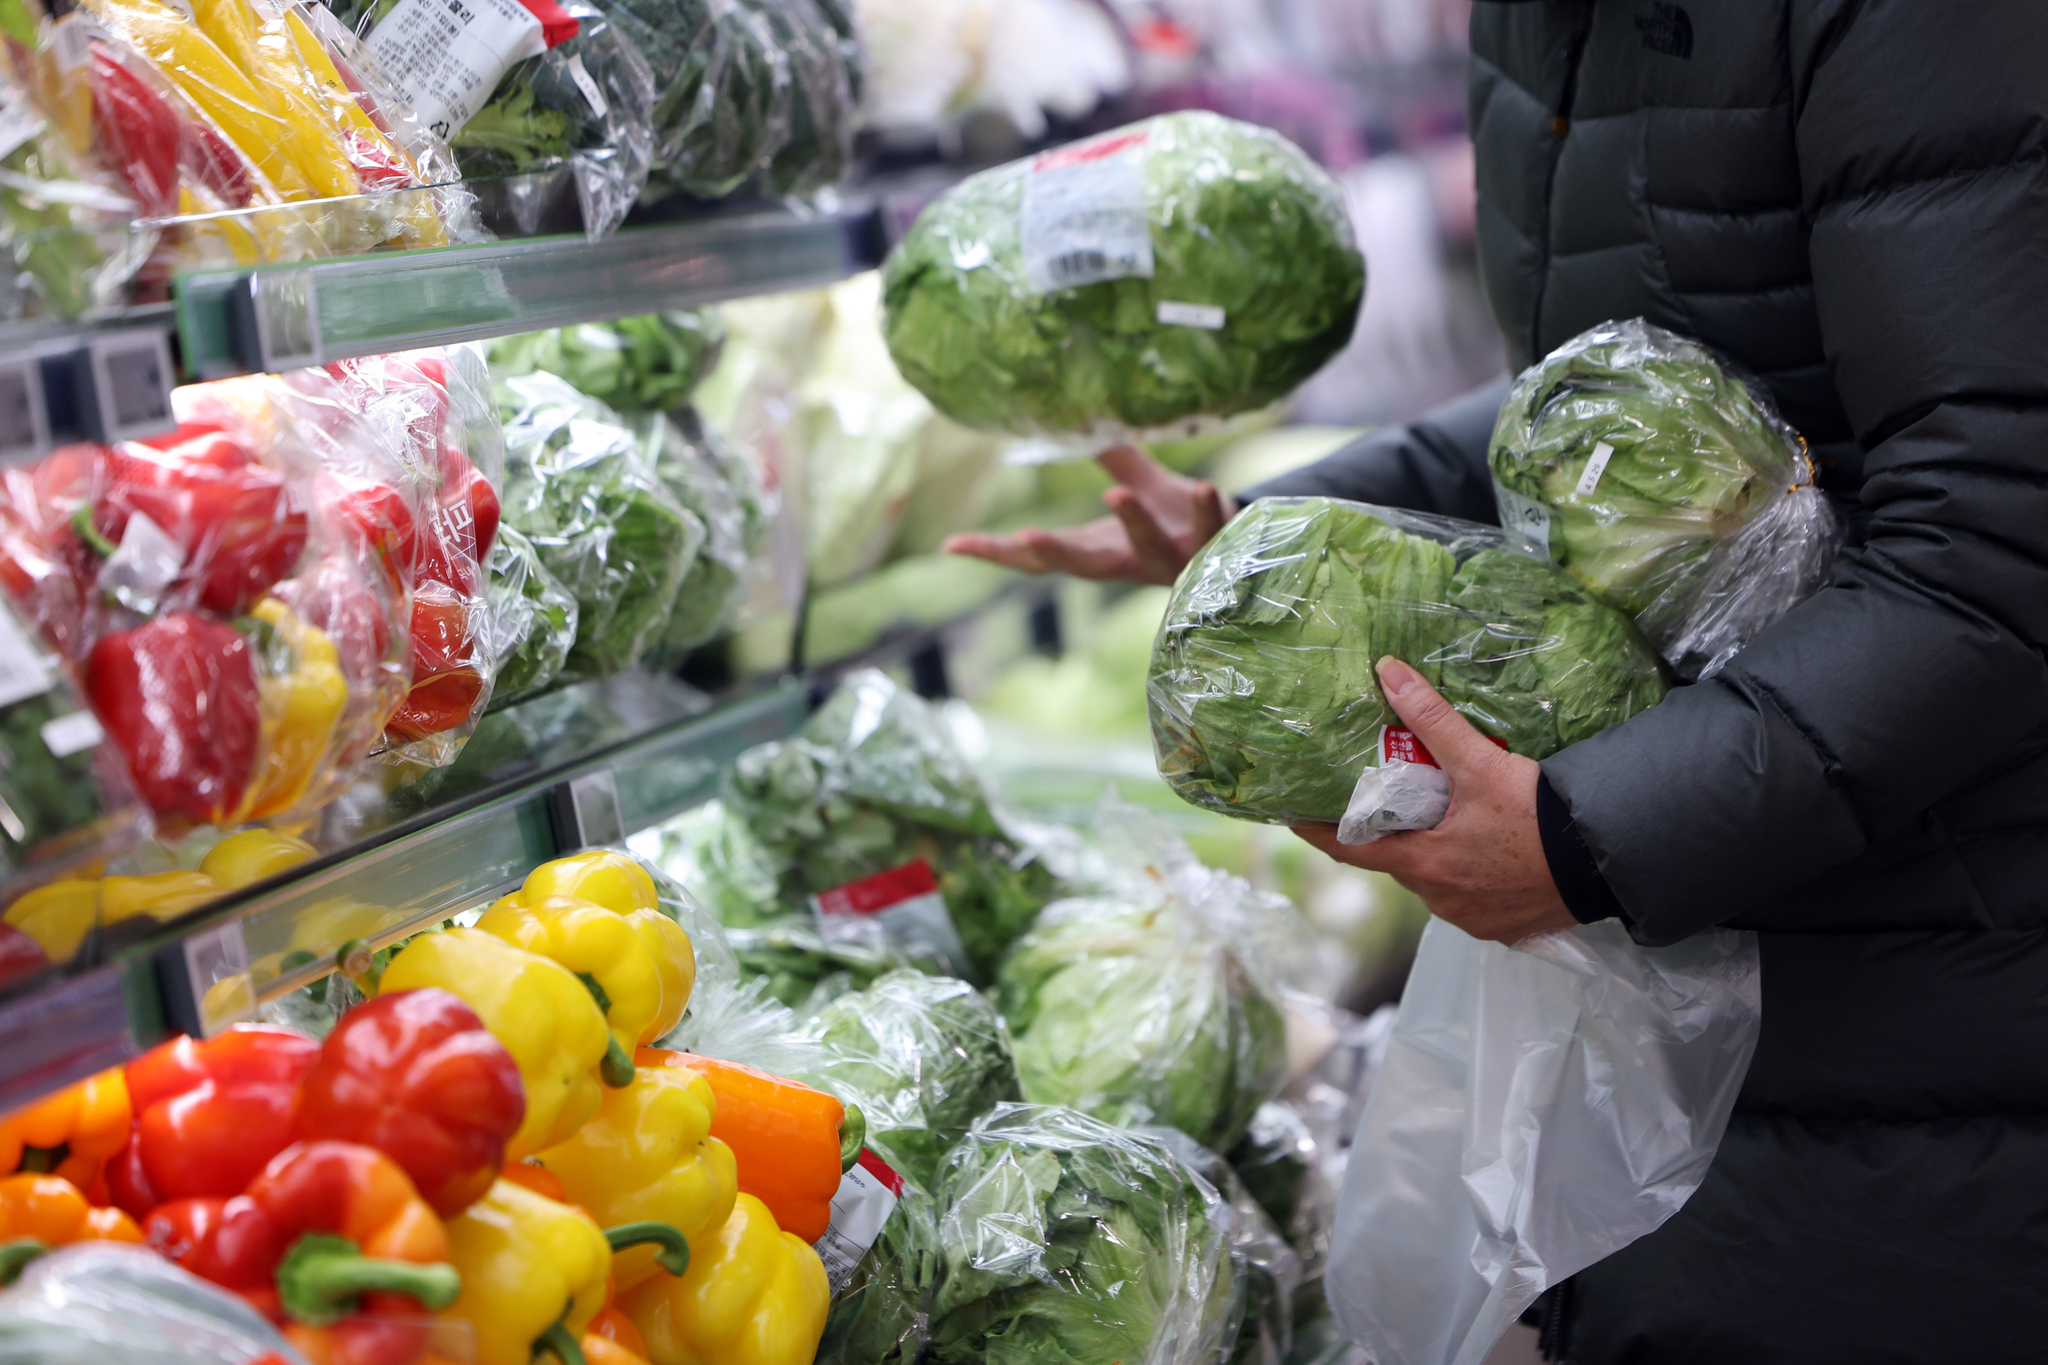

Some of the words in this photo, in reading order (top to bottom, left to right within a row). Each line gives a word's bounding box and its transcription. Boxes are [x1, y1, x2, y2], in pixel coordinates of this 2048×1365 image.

[1654, 1, 1675, 20] THE
[1634, 13, 1674, 38] NORTH
[1640, 32, 1671, 54] FACE
[1390, 740, 1413, 752] 신선을
